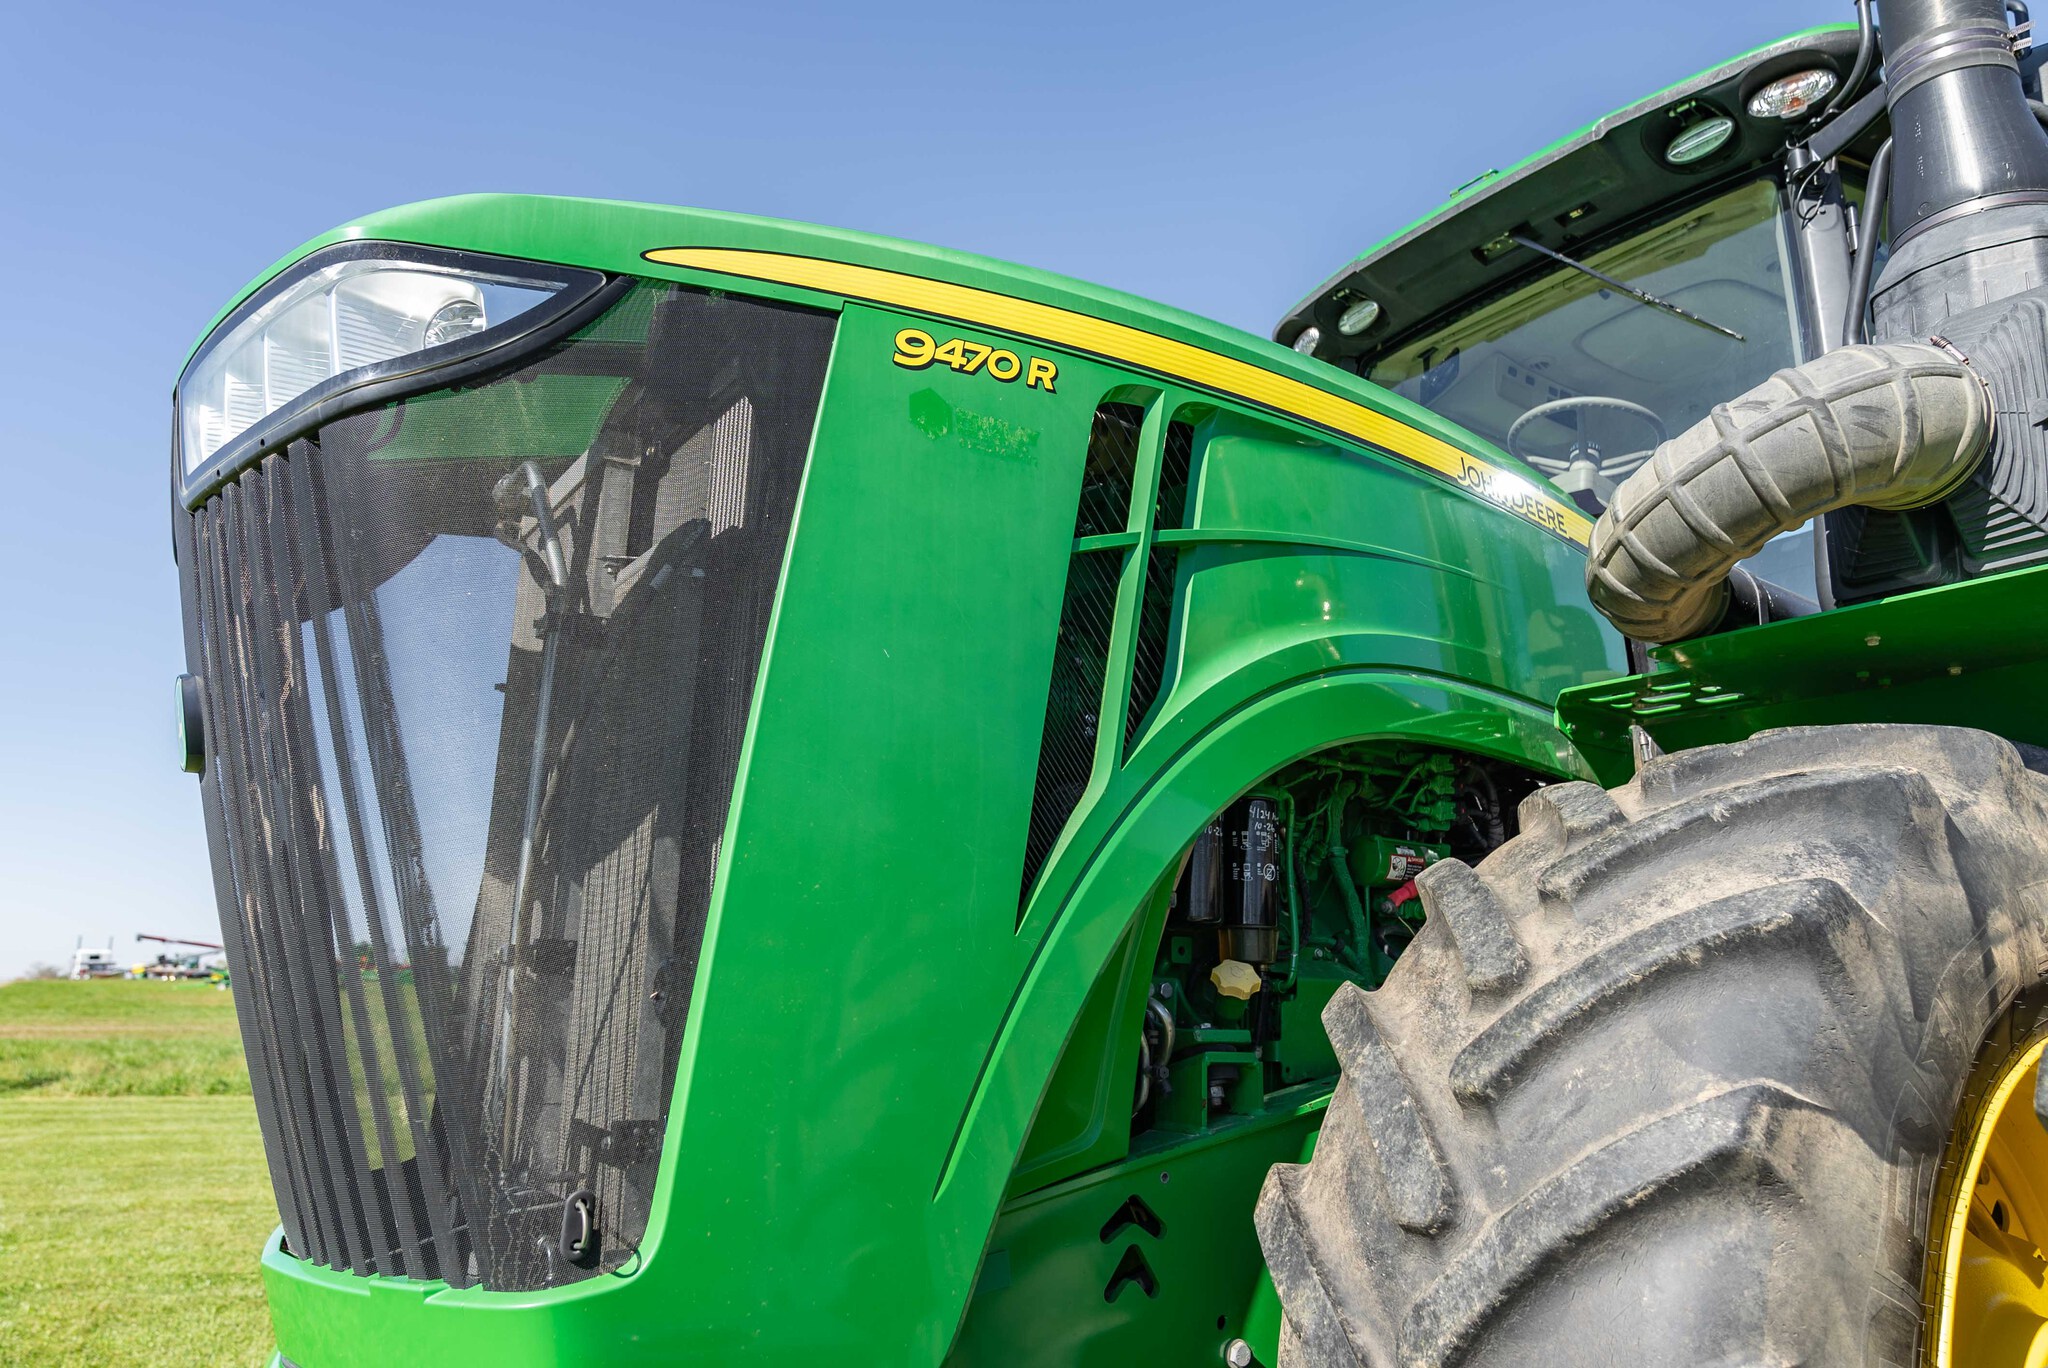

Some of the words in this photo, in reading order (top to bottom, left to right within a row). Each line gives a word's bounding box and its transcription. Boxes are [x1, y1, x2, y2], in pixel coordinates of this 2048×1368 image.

[893, 328, 1022, 383] 9470
[1026, 356, 1059, 394] R
[1457, 456, 1508, 506] JOH
[1511, 491, 1569, 538] DEERE
[1249, 805, 1270, 820] 4124
